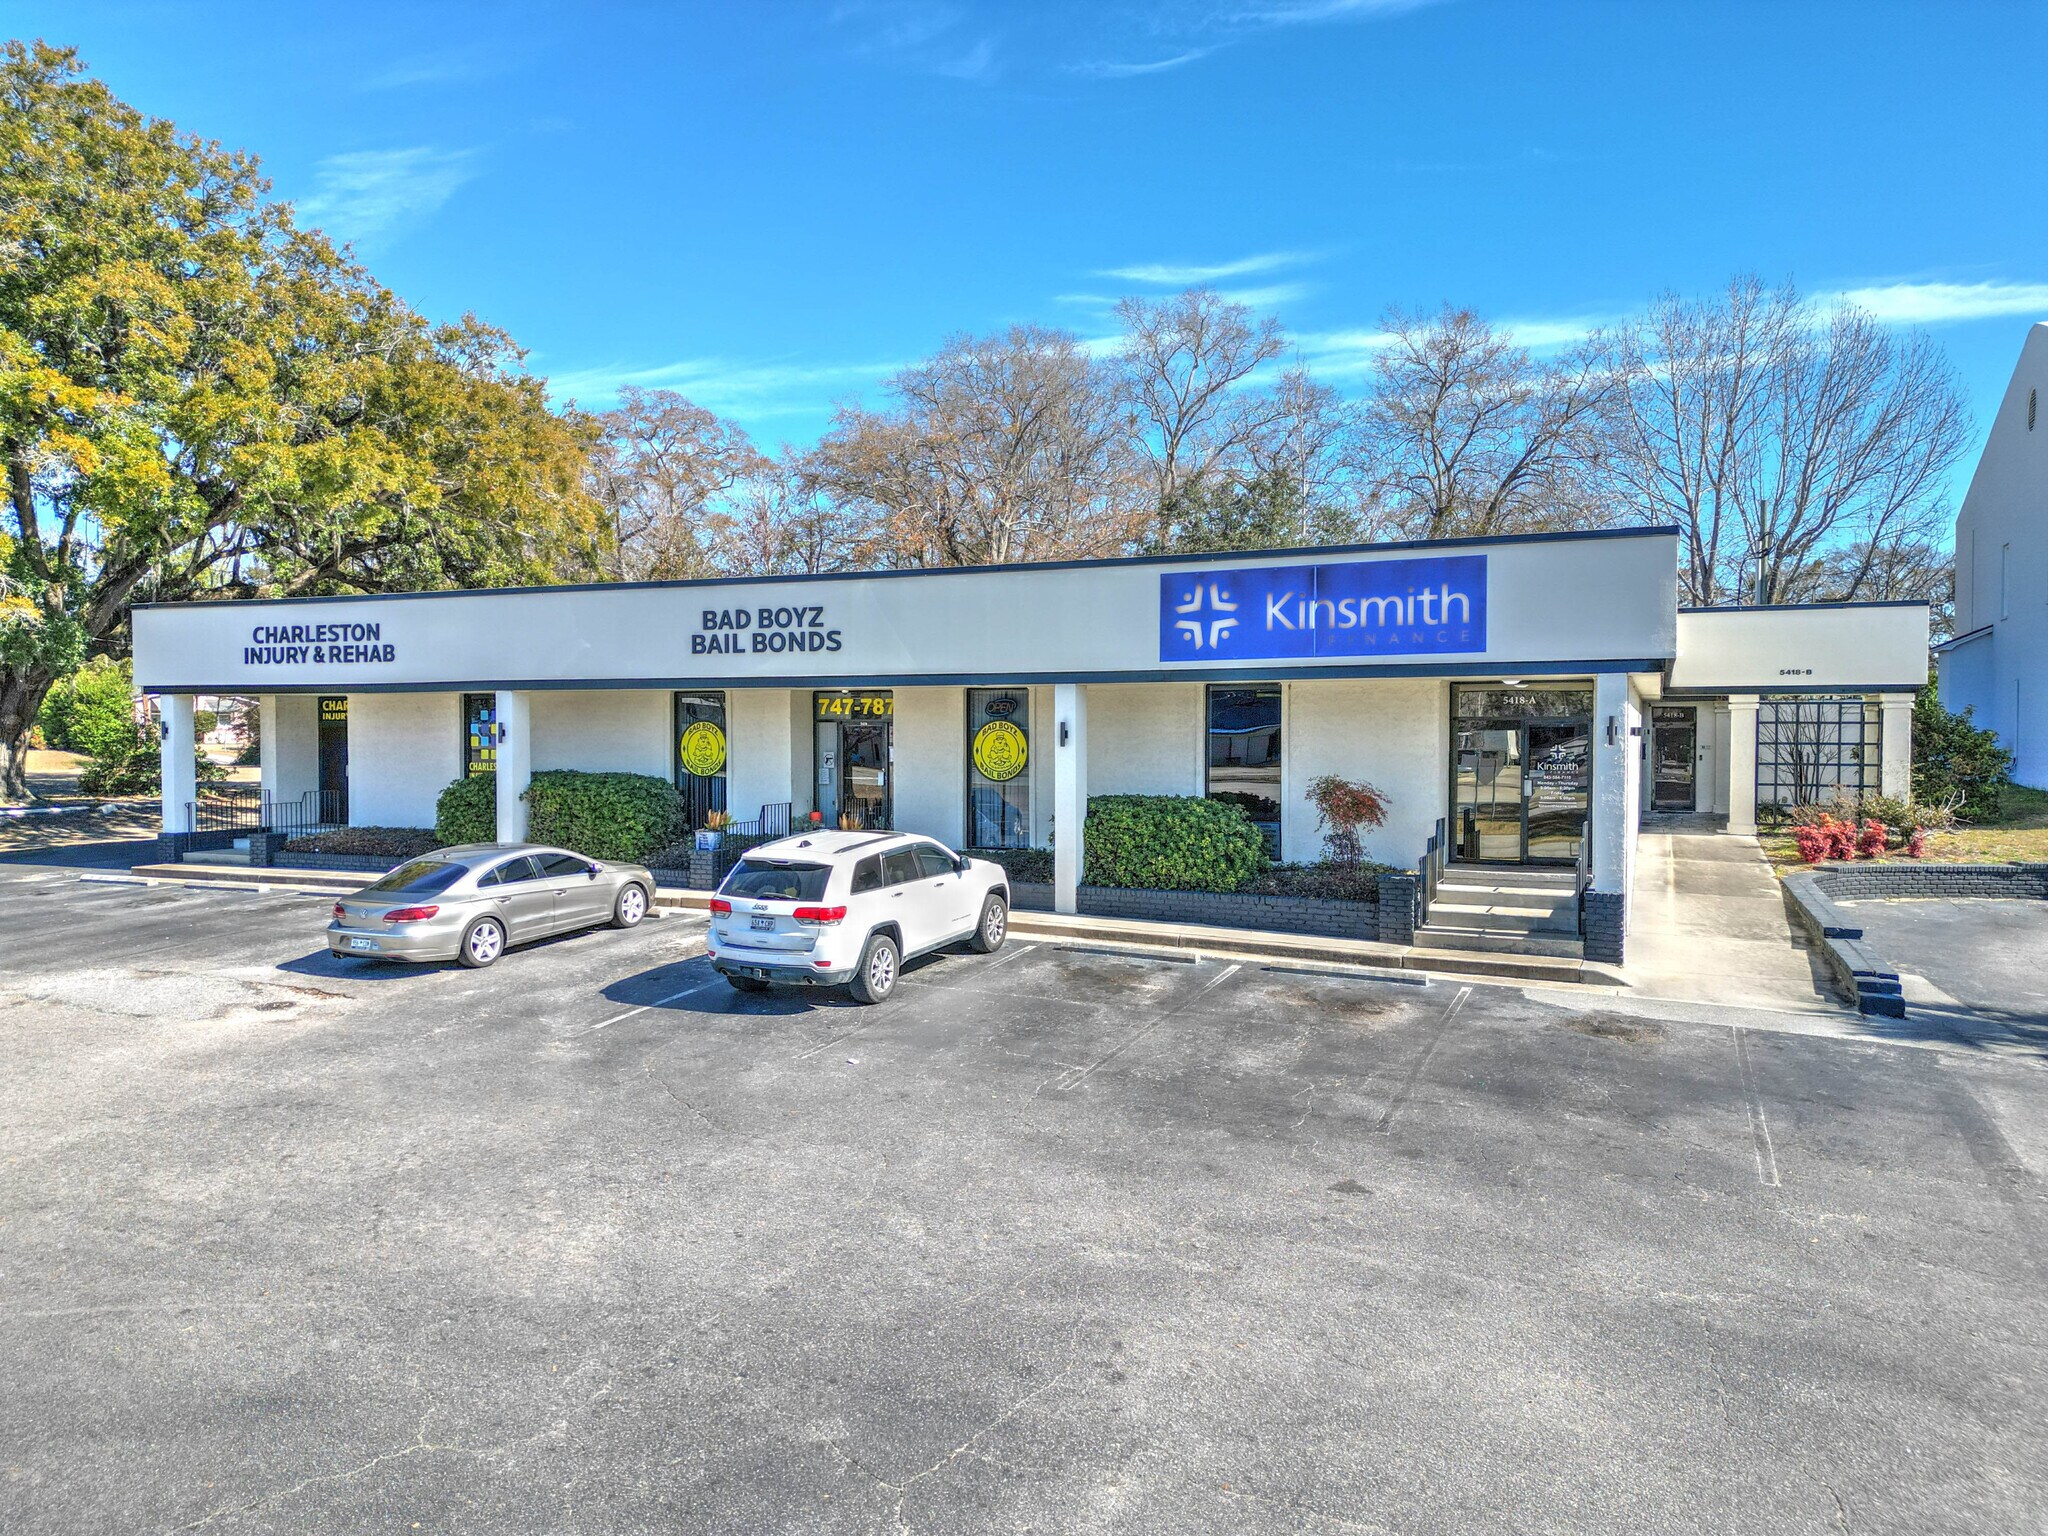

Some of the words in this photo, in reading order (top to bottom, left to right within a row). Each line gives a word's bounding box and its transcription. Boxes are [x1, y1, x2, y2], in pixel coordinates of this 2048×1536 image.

[1266, 583, 1470, 631] Kinsmith
[702, 610, 751, 630] BAD
[758, 606, 824, 629] BOYZ
[252, 623, 380, 644] CHARLESTON
[691, 633, 746, 654] BAIL
[752, 630, 842, 653] BONDS
[1328, 629, 1471, 646] FINANCE
[244, 645, 309, 664] INJURY
[312, 645, 326, 663] &
[328, 644, 395, 663] REHAB
[988, 702, 1015, 713] OPEN
[1503, 696, 1536, 705] 5418-A
[688, 723, 700, 735] BAD
[982, 723, 997, 736] BAD
[999, 723, 1018, 737] BOYZ
[980, 762, 995, 778] BAIL
[997, 762, 1021, 779] BONDS
[1537, 762, 1579, 770] Kinsmith
